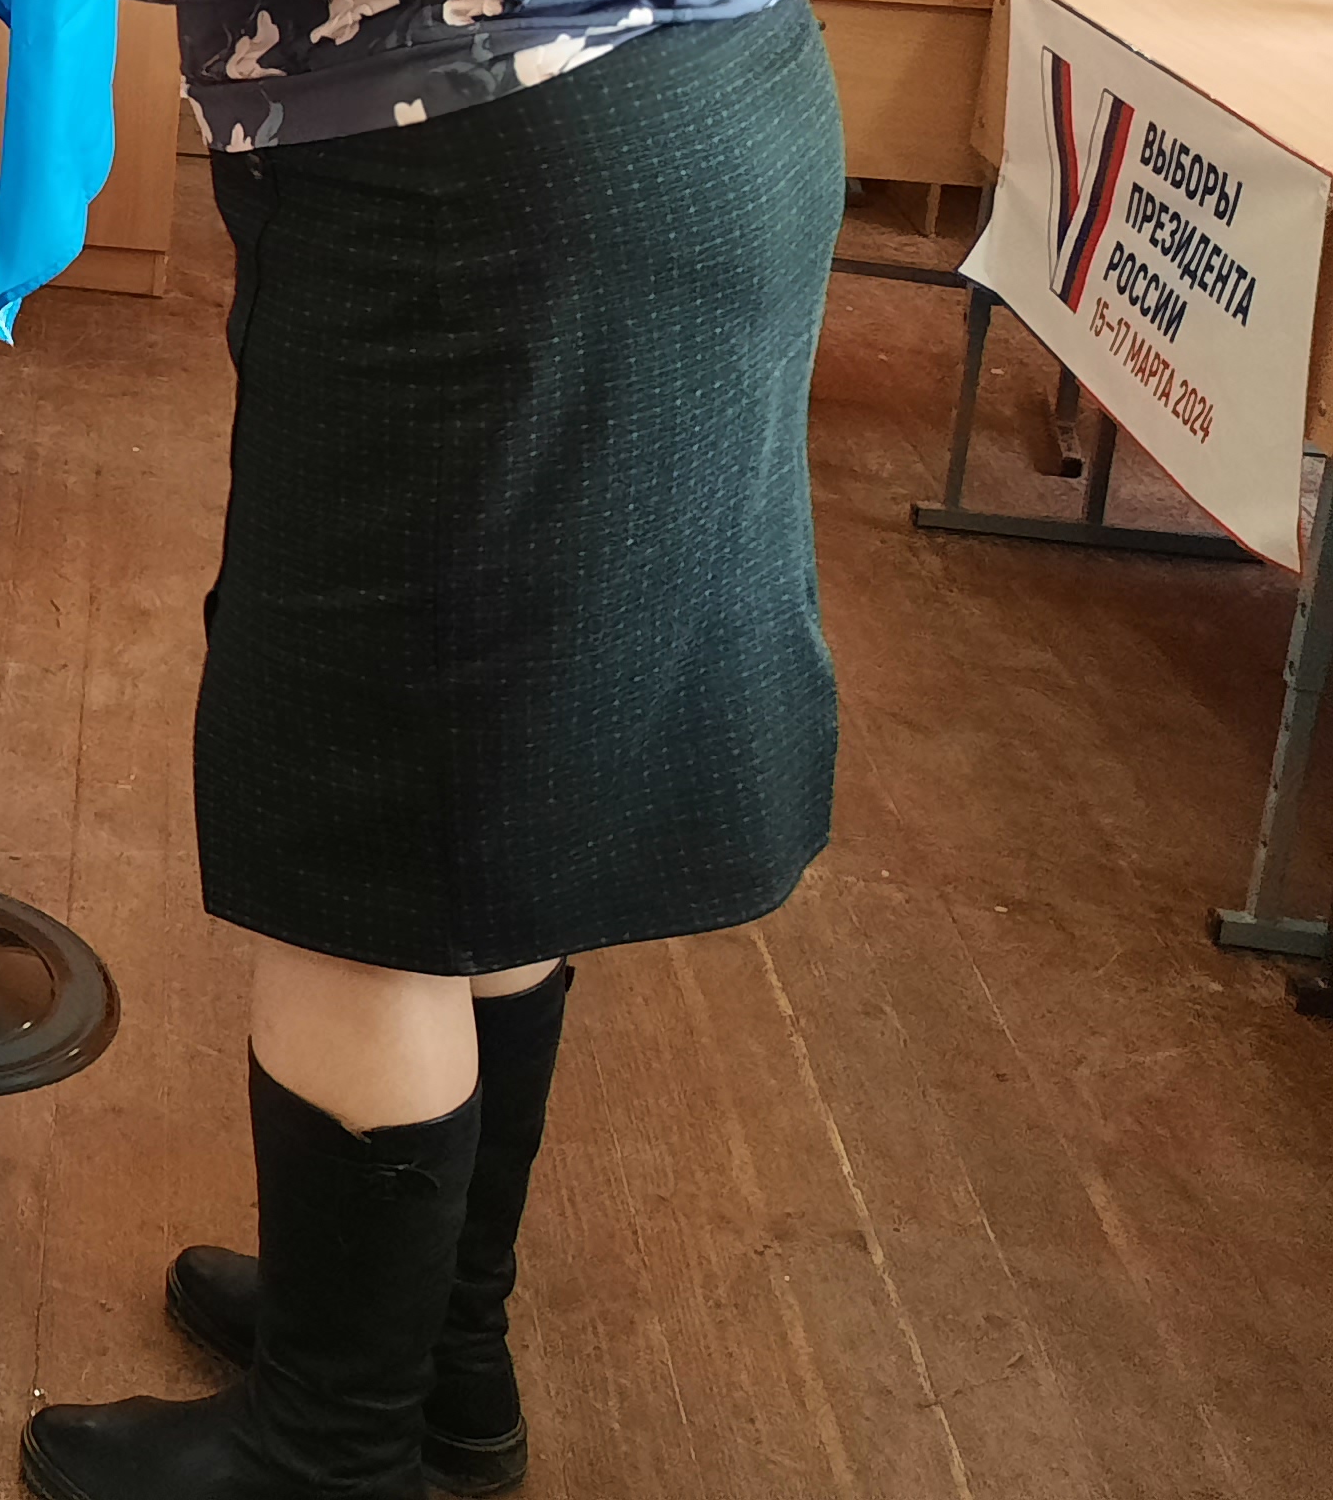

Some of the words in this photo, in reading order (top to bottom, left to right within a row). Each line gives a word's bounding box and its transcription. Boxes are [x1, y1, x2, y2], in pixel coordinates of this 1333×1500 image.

[1140, 121, 1242, 228] ВЫБОРЫ
[1103, 242, 1188, 343] РОССИИ
[1125, 181, 1257, 327] ПРЕЗИДЕНТА
[1129, 339, 1176, 407] МАРТА
[1171, 378, 1213, 444] 2024
